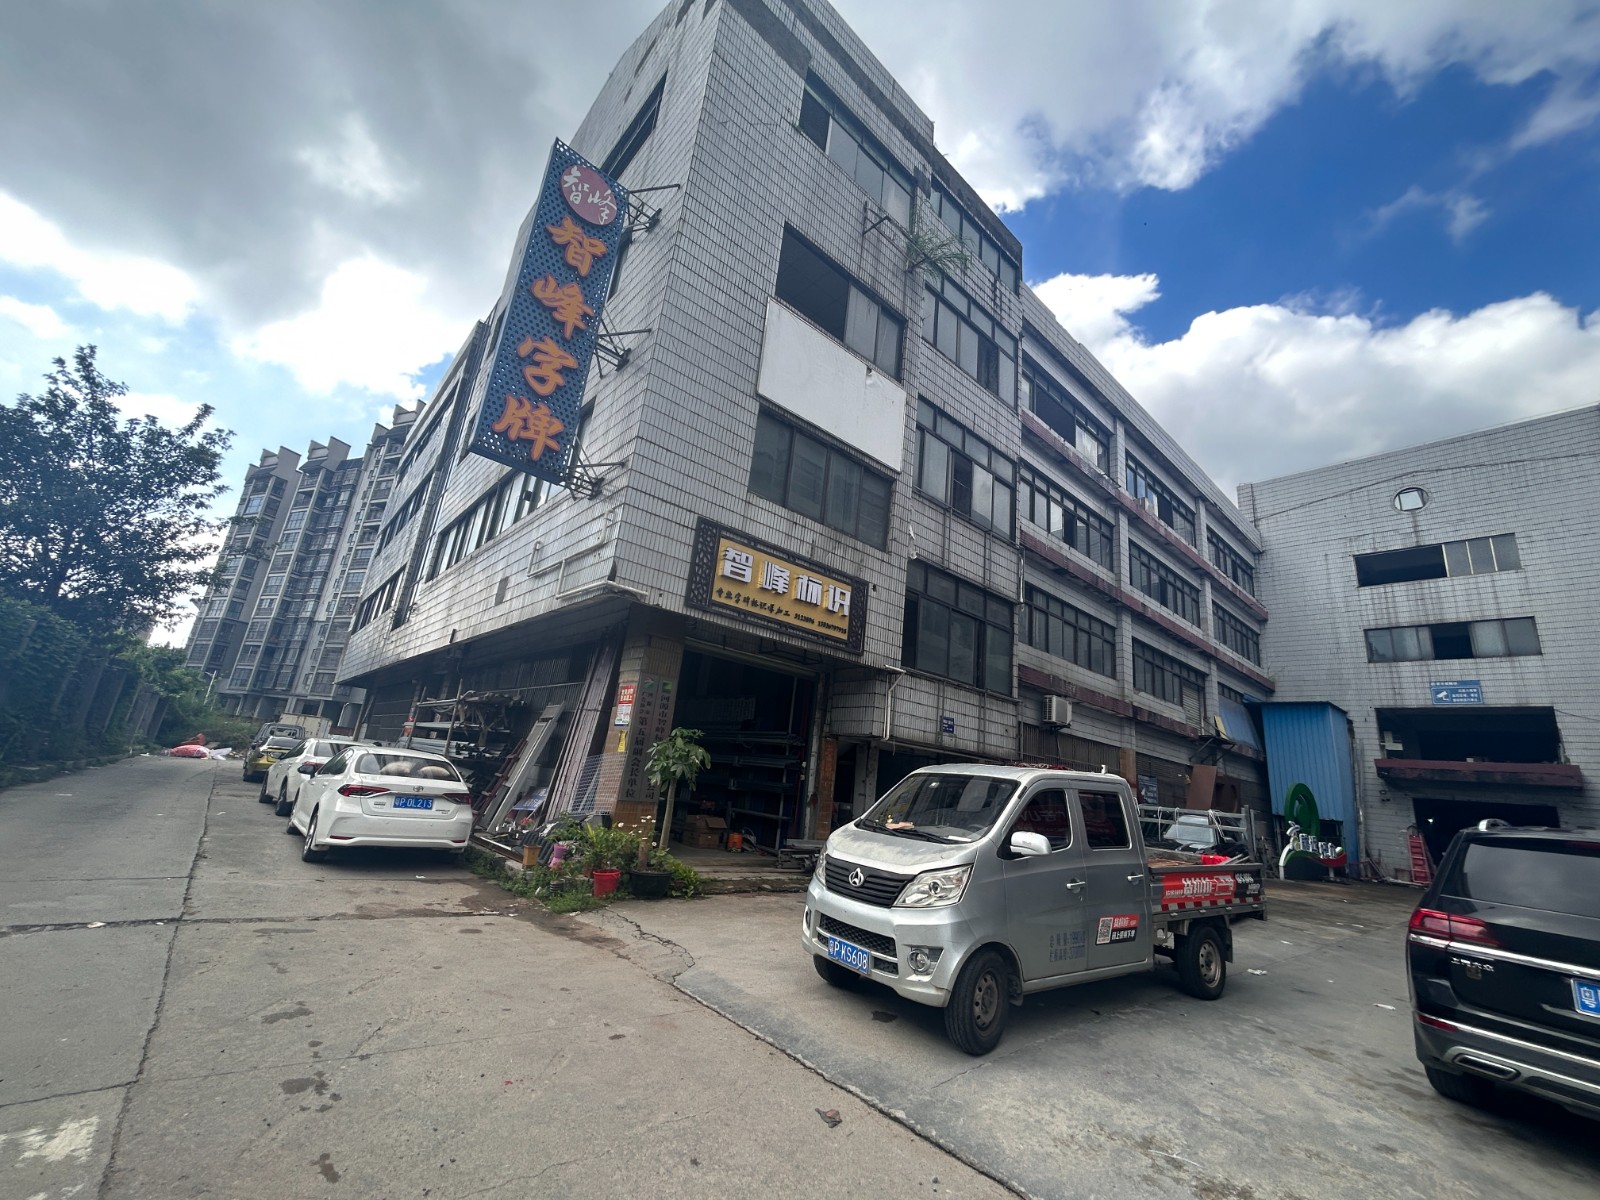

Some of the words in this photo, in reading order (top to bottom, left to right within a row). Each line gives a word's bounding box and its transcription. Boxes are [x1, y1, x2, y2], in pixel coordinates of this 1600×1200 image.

[491, 214, 609, 462] 智峰字牌
[722, 546, 851, 617] 智峰标识
